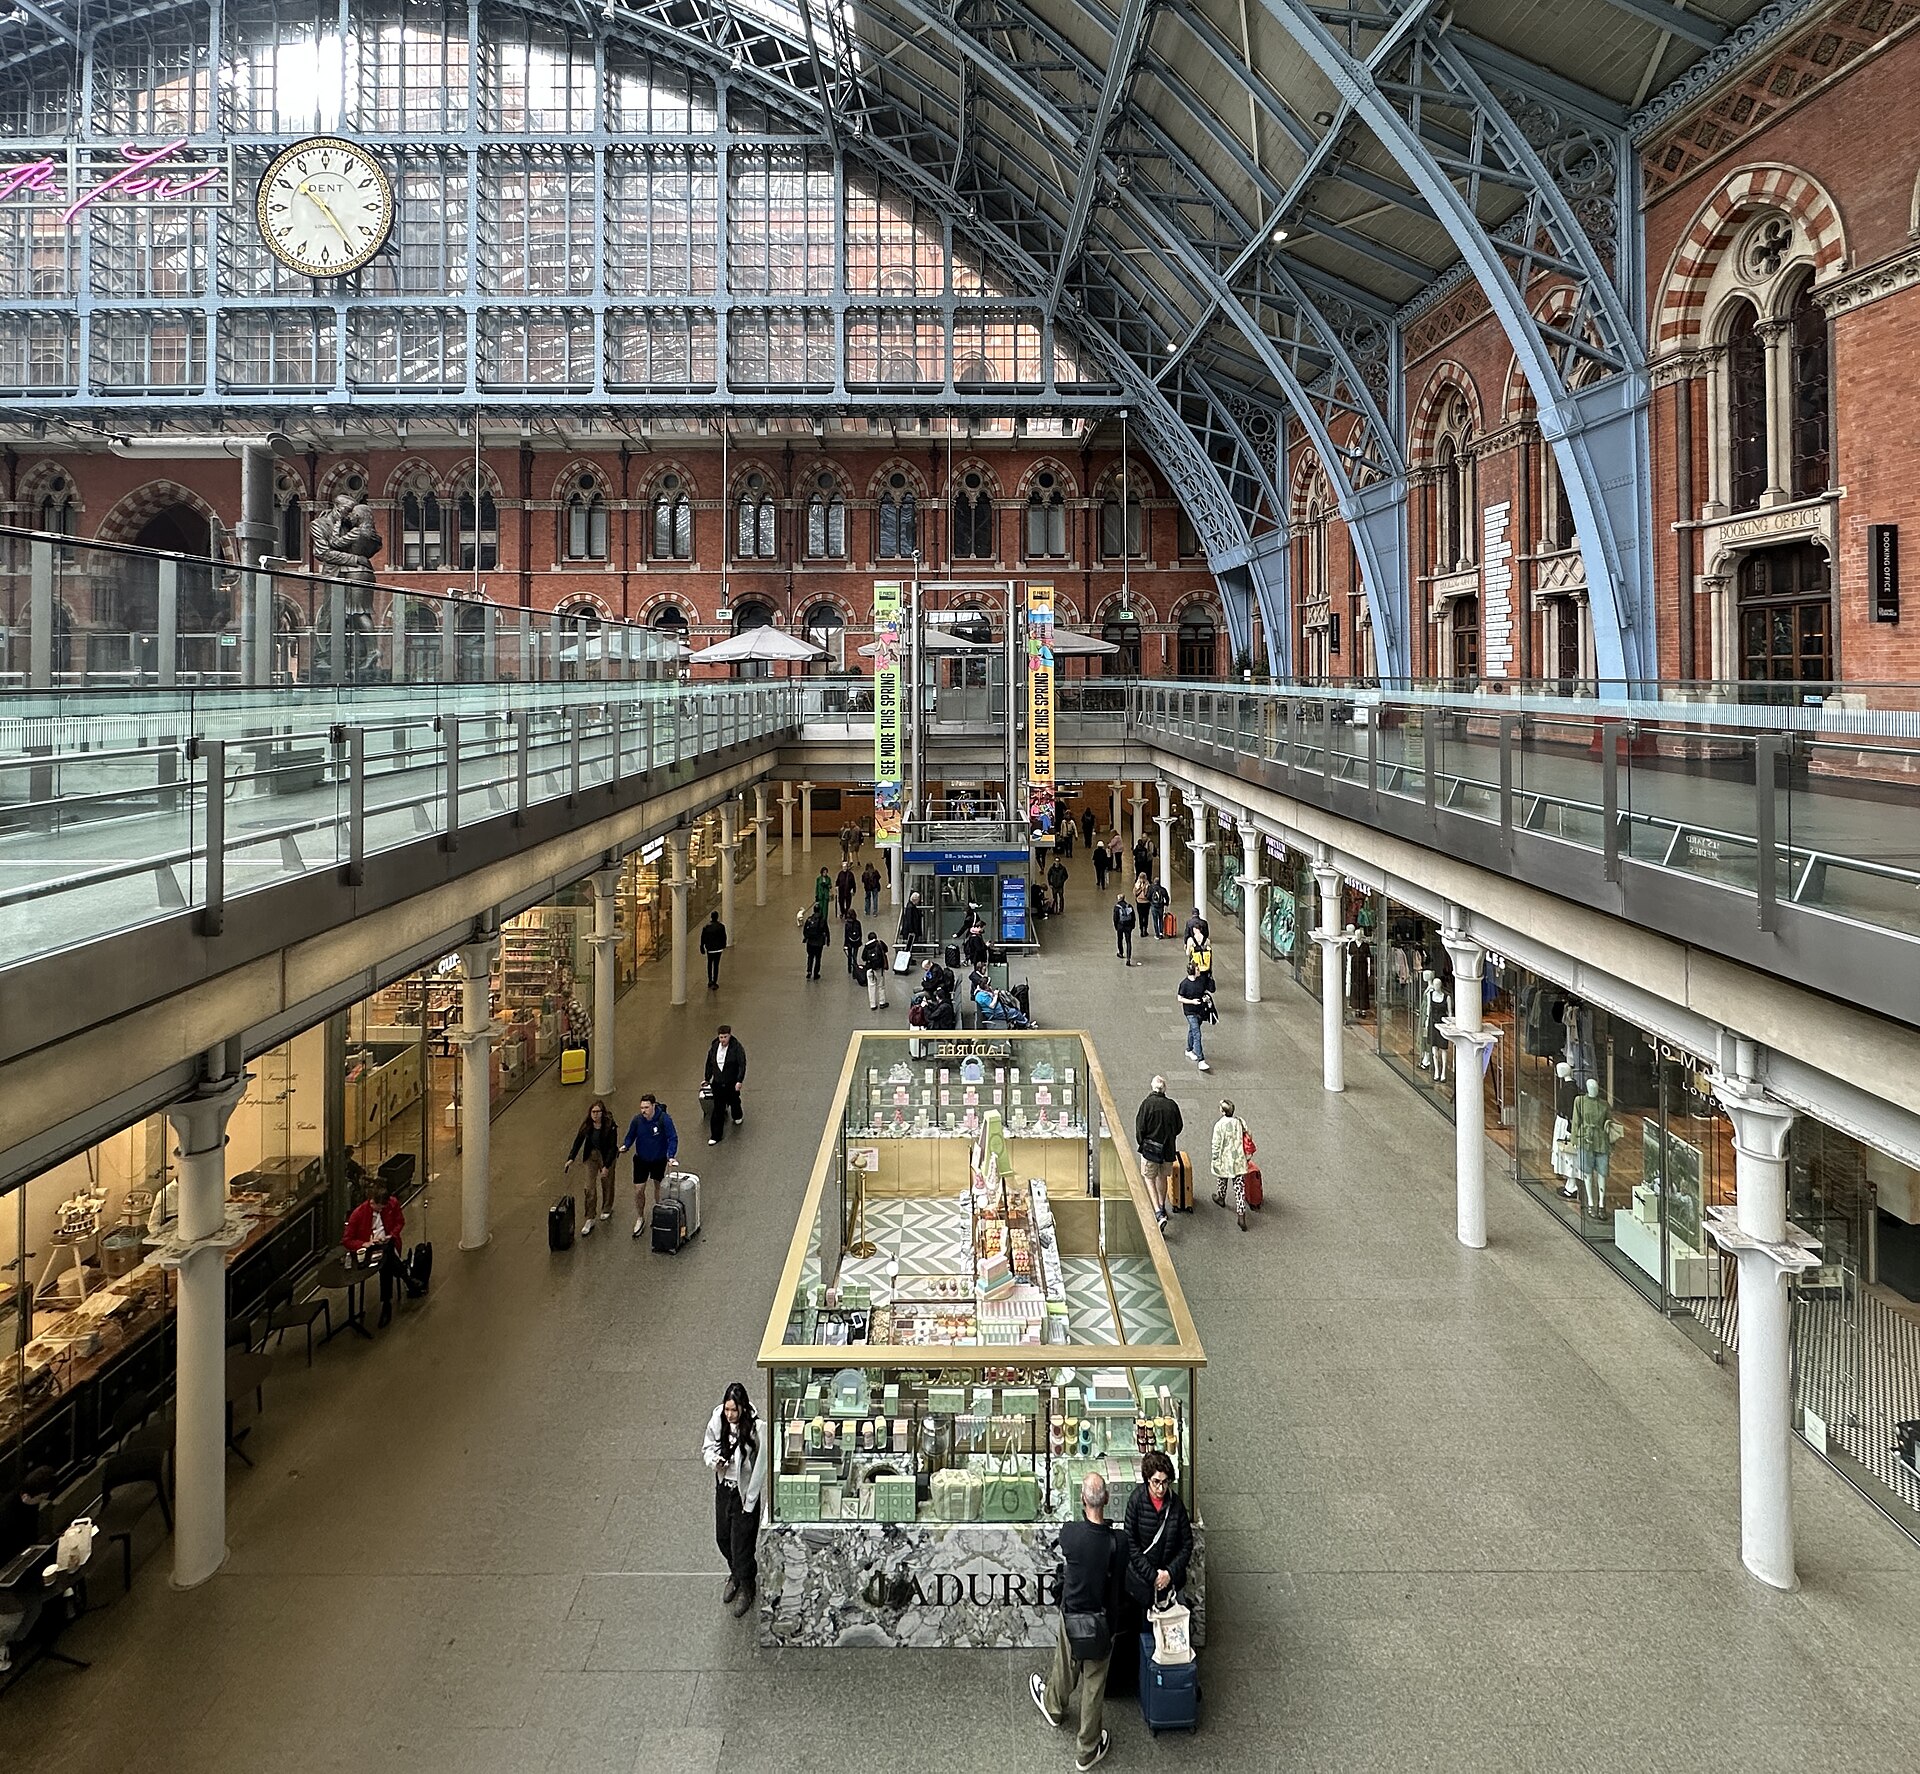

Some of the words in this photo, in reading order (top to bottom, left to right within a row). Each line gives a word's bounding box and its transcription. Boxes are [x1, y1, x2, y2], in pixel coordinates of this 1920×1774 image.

[308, 184, 344, 193] DENT
[1719, 517, 1768, 540] BOOKING
[1774, 507, 1821, 530] OFFICE
[1883, 531, 1891, 566] BOOKING
[1883, 566, 1891, 593] OFFICE
[880, 673, 896, 706] SPRING
[1034, 672, 1049, 706] SPRING
[880, 709, 896, 730] THIS
[1034, 708, 1049, 729] THIS
[880, 732, 896, 757] MORE
[1034, 732, 1049, 757] MORE
[880, 760, 896, 775] SEE
[1034, 759, 1049, 775] SEE
[952, 864, 963, 872] Lift
[1682, 1081, 1727, 1112] LONDO
